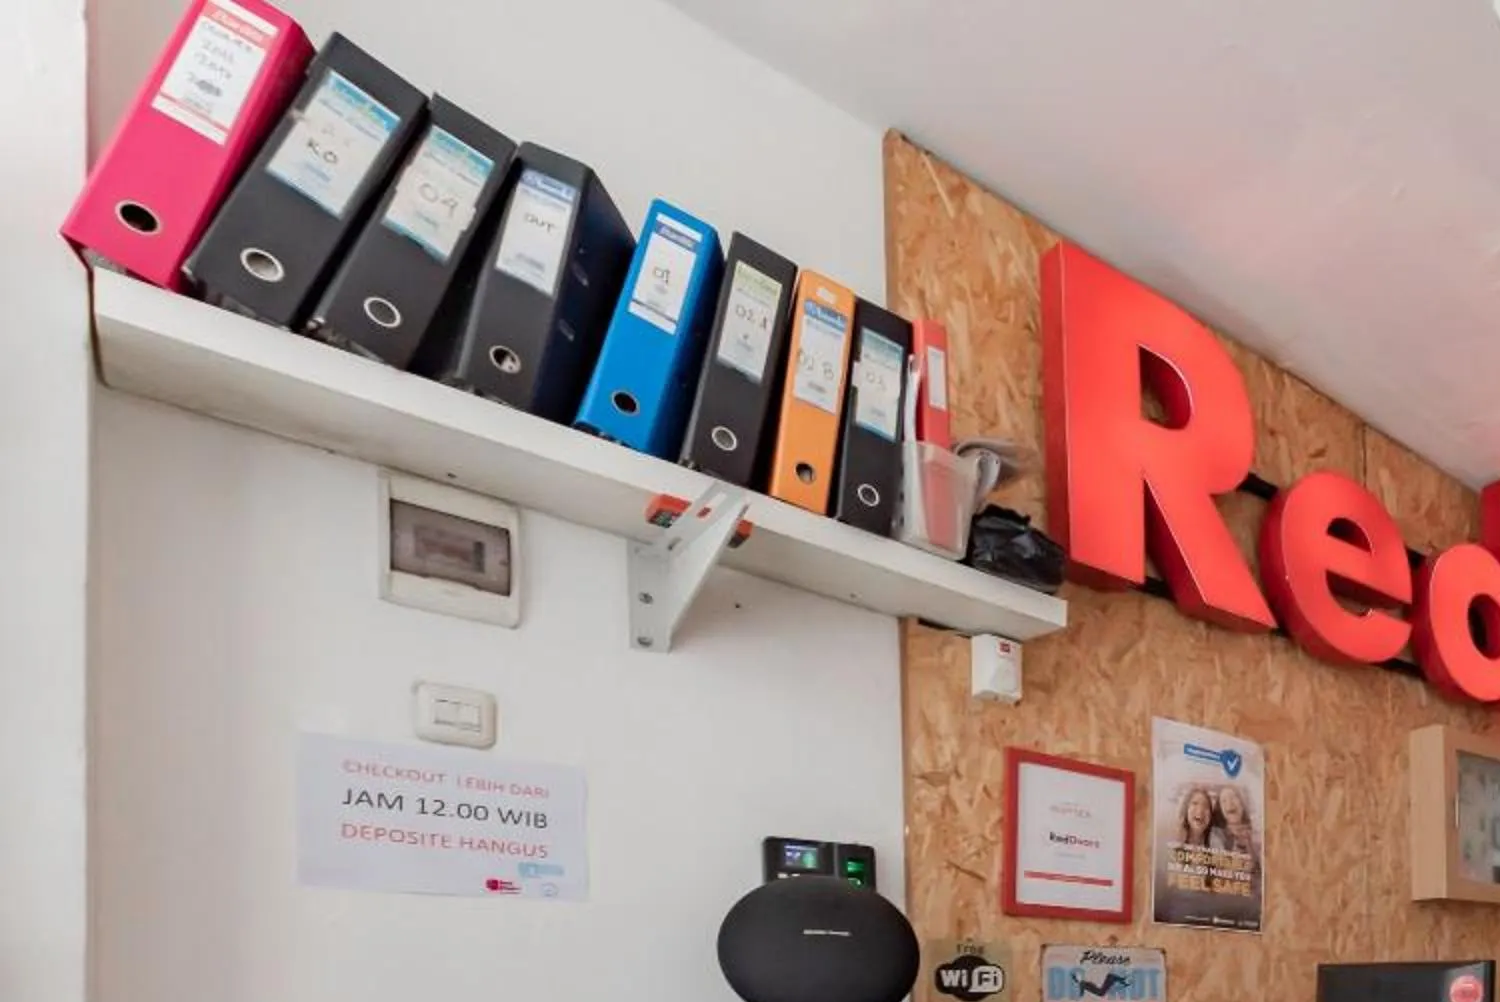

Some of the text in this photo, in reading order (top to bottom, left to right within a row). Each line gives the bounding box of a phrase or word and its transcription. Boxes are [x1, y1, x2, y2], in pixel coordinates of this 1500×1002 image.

[341, 758, 448, 784] CHECKOUT
[508, 782, 550, 799] DARI
[341, 787, 549, 829] JAM 12.00 WIB
[340, 821, 550, 860] DEPOSITE HANGUS
